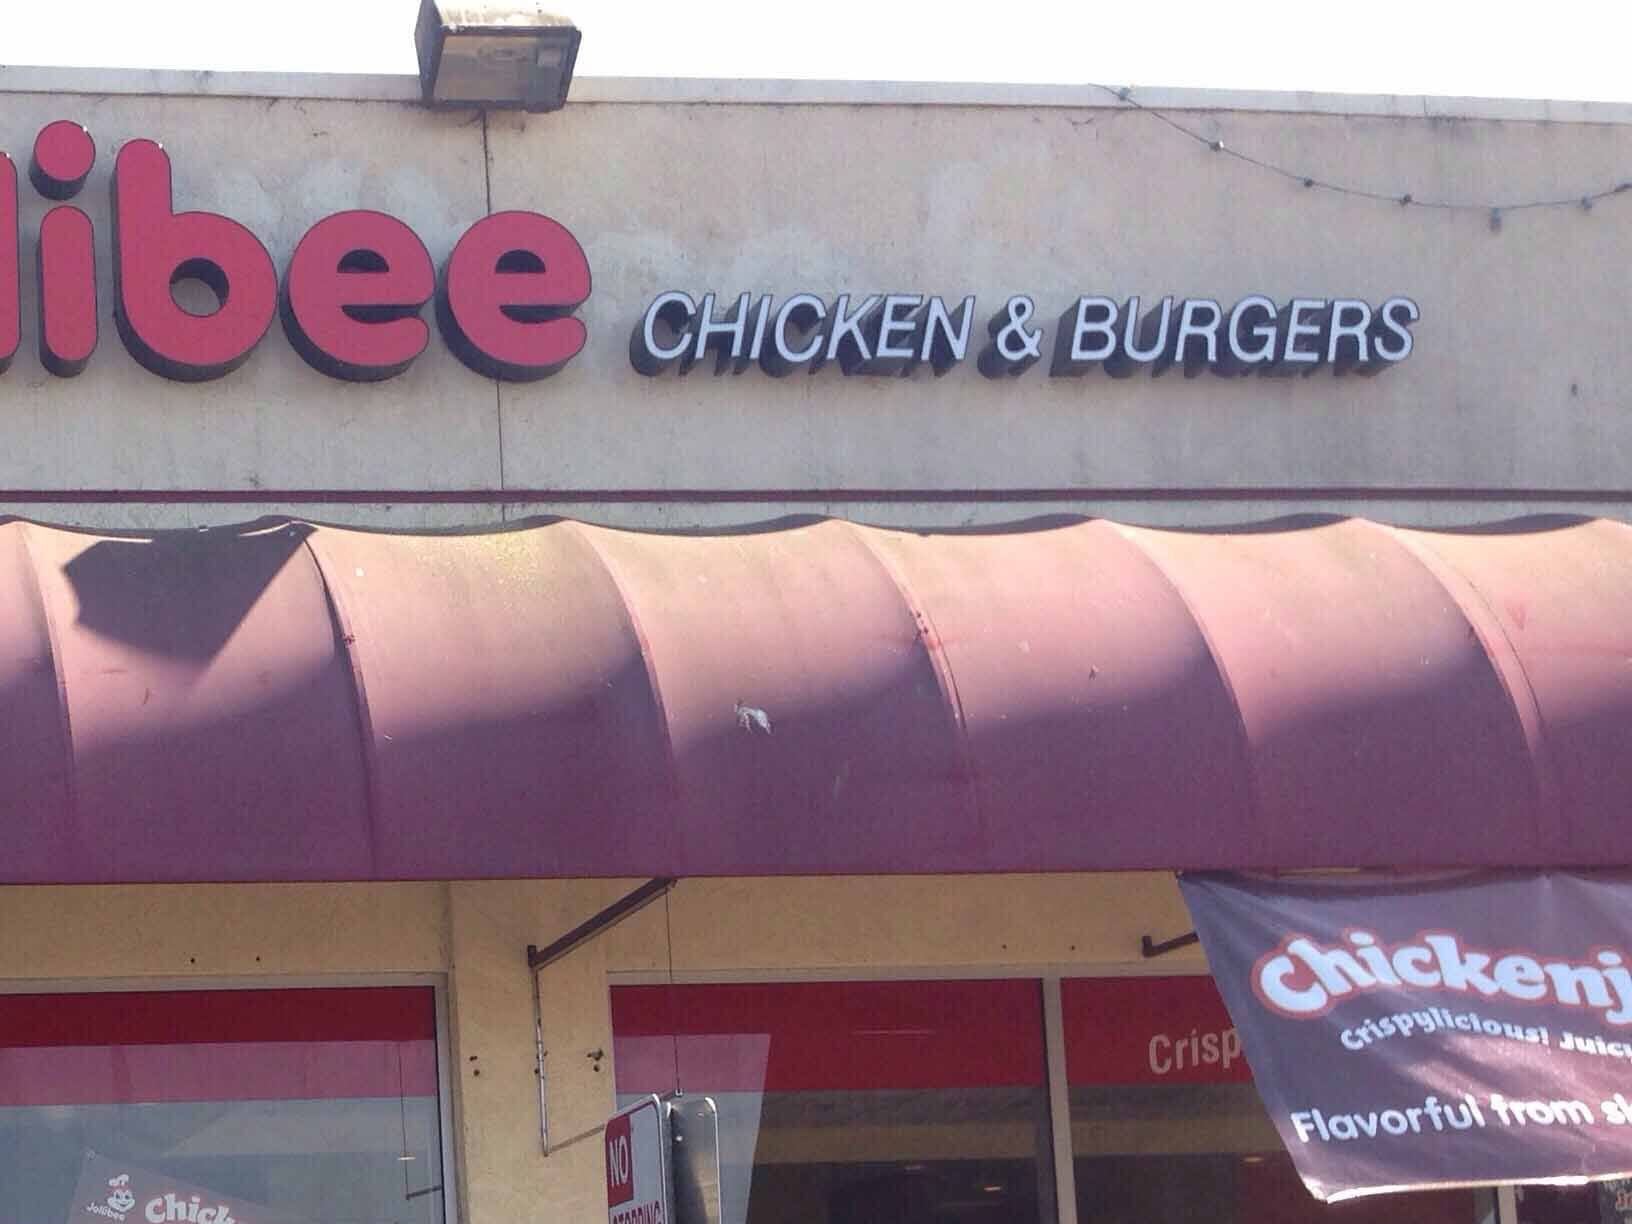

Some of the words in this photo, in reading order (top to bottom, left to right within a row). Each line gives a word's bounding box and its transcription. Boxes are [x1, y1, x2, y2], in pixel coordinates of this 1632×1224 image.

[633, 291, 976, 374] CHICKEN
[982, 295, 1042, 372] &
[1058, 295, 1421, 374] BURGERS
[1340, 1007, 1549, 1052] Crispylicious!
[1290, 1093, 1484, 1144] Flavorful
[1491, 1093, 1595, 1126] from
[609, 1134, 629, 1187] NO
[86, 1202, 126, 1222] Jollibee
